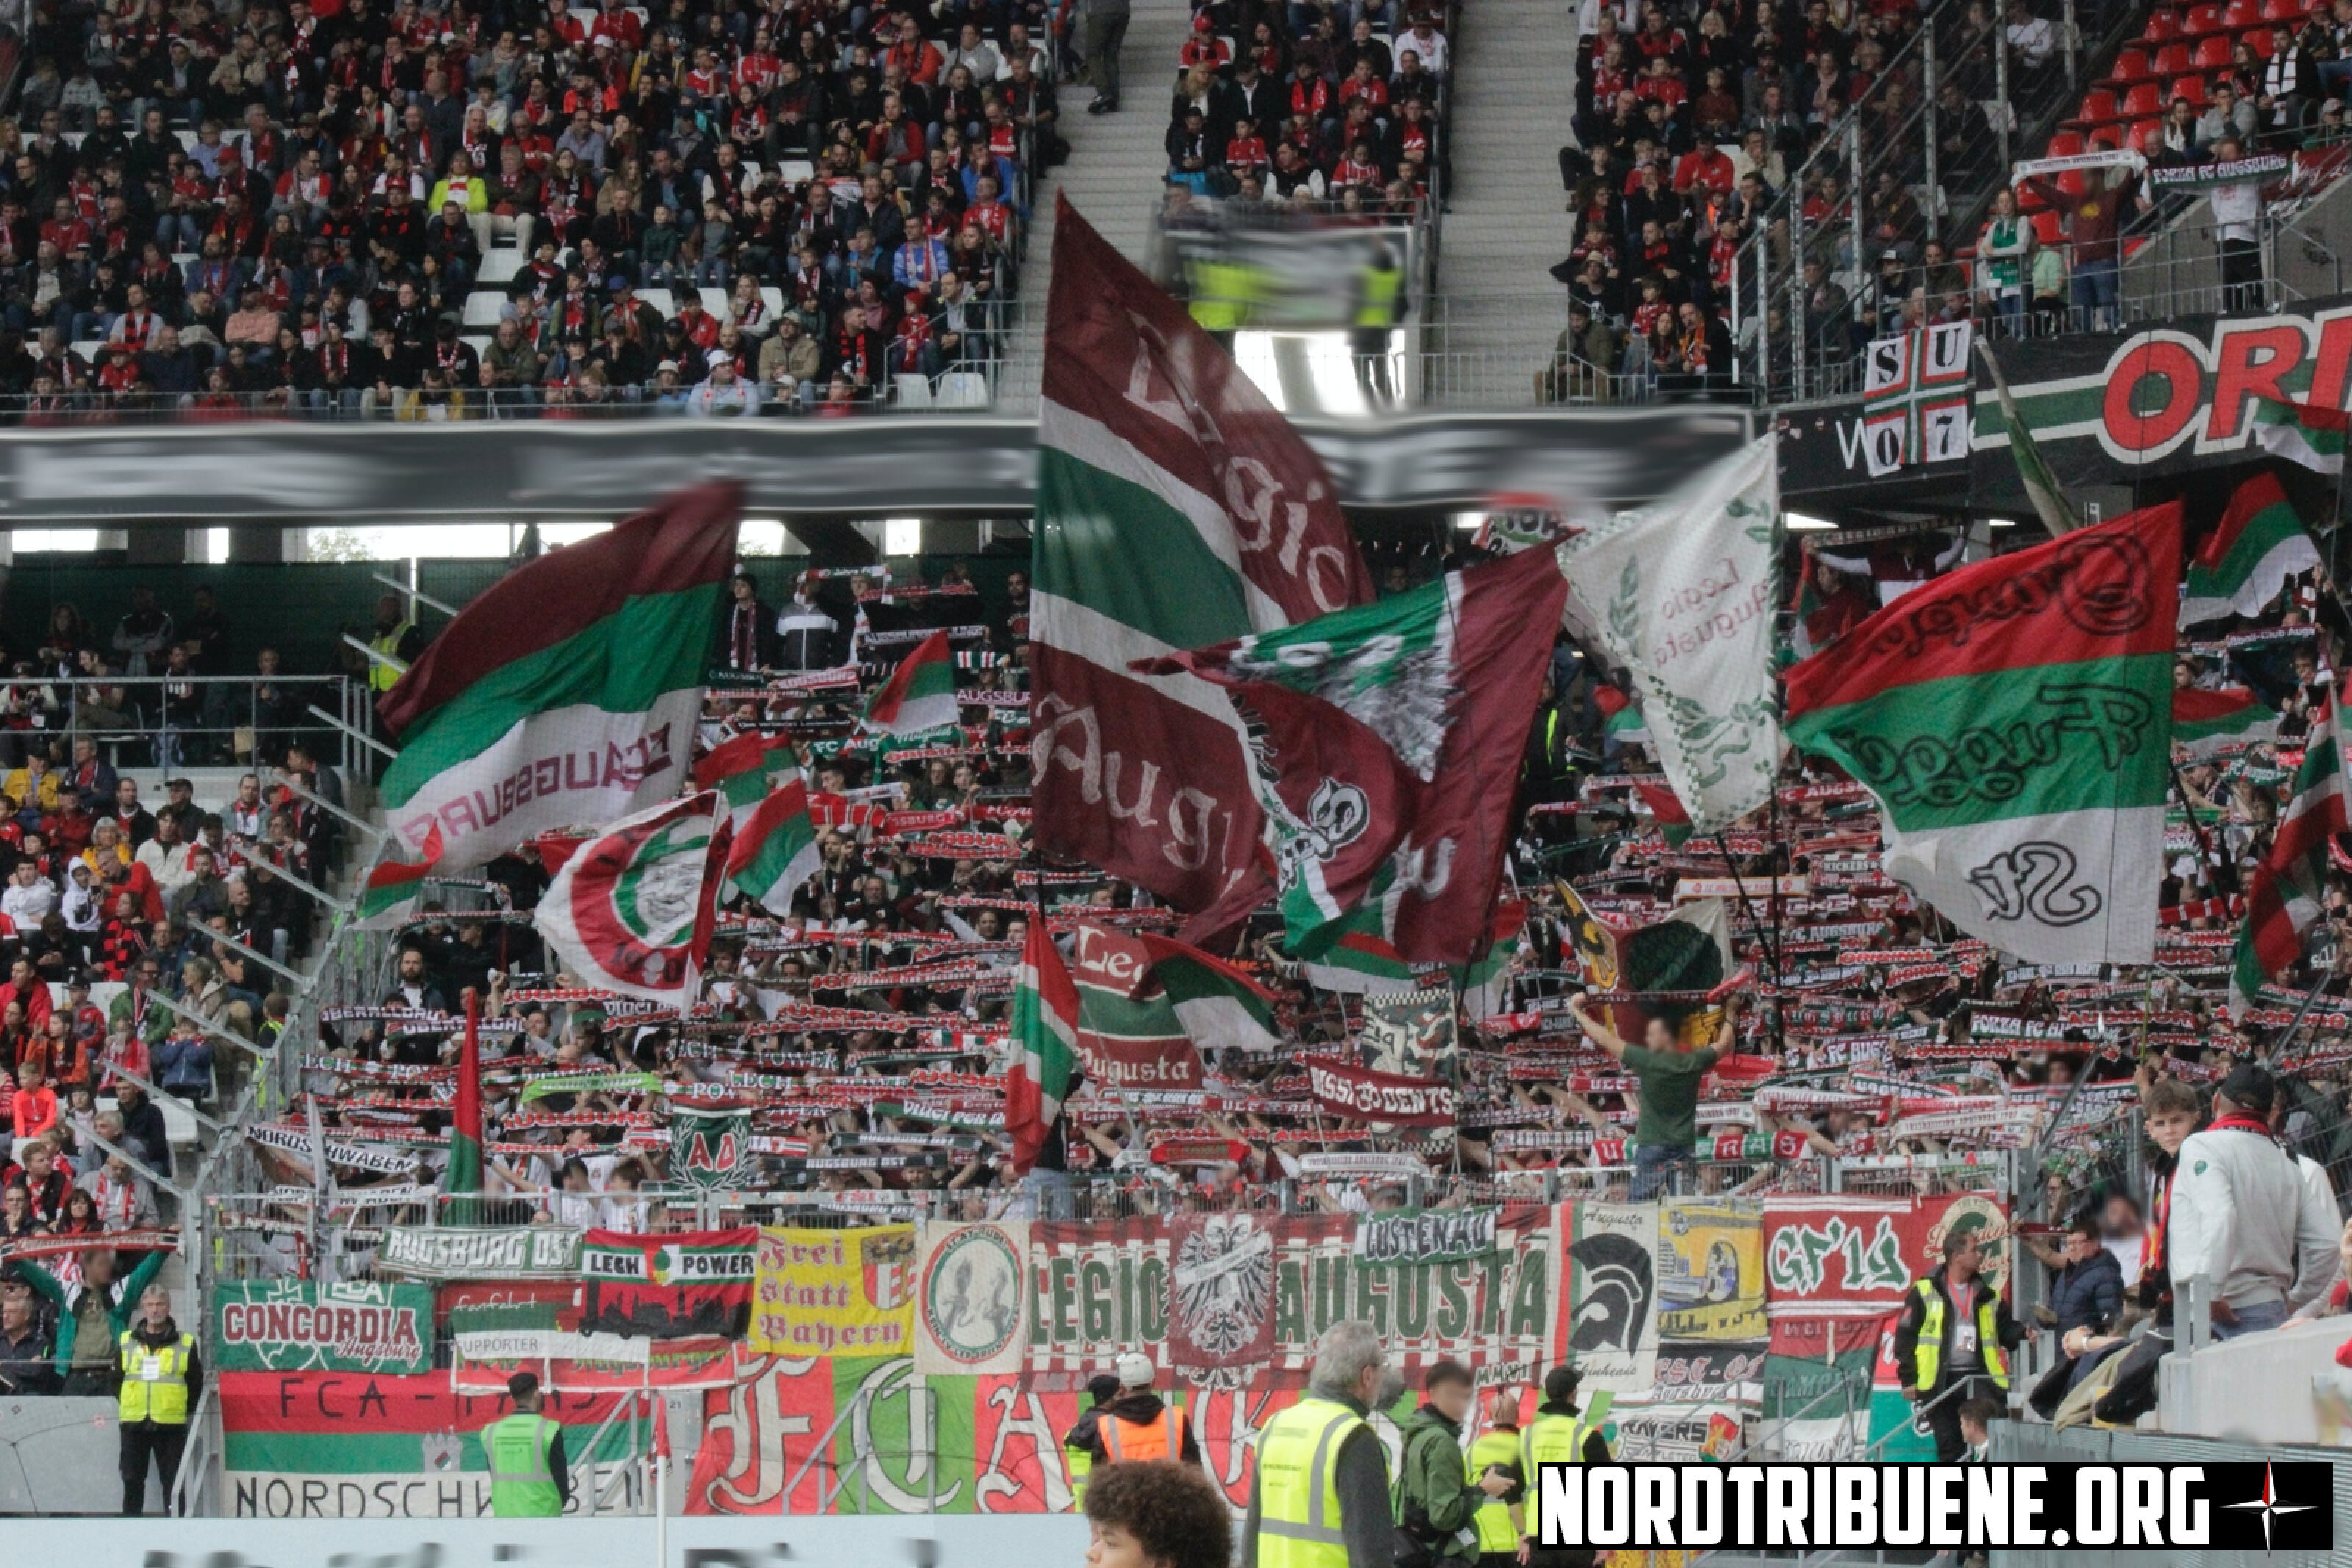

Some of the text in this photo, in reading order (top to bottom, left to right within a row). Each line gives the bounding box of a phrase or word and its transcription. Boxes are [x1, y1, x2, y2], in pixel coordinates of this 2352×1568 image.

[2218, 154, 2287, 178] AUGSBURG
[1836, 420, 1867, 470] W
[729, 1069, 792, 1090] LECH
[248, 1124, 413, 1172] NORDSHWABEN
[806, 1156, 906, 1169] AUGSBURG OST
[1583, 1206, 1643, 1231] Augusta
[388, 1229, 529, 1270] AUGSBURG
[589, 1251, 754, 1275] LECH POWER
[759, 1234, 845, 1271] Frei
[1030, 1255, 1165, 1346] LEGIO
[223, 1303, 417, 1345] CONCORDIA
[759, 1314, 902, 1352] Bayern
[335, 1336, 422, 1369] Augsburg
[281, 1379, 387, 1418] FCA
[670, 1400, 682, 1409] 21
[235, 1470, 644, 1517] NORDSCHBEN
